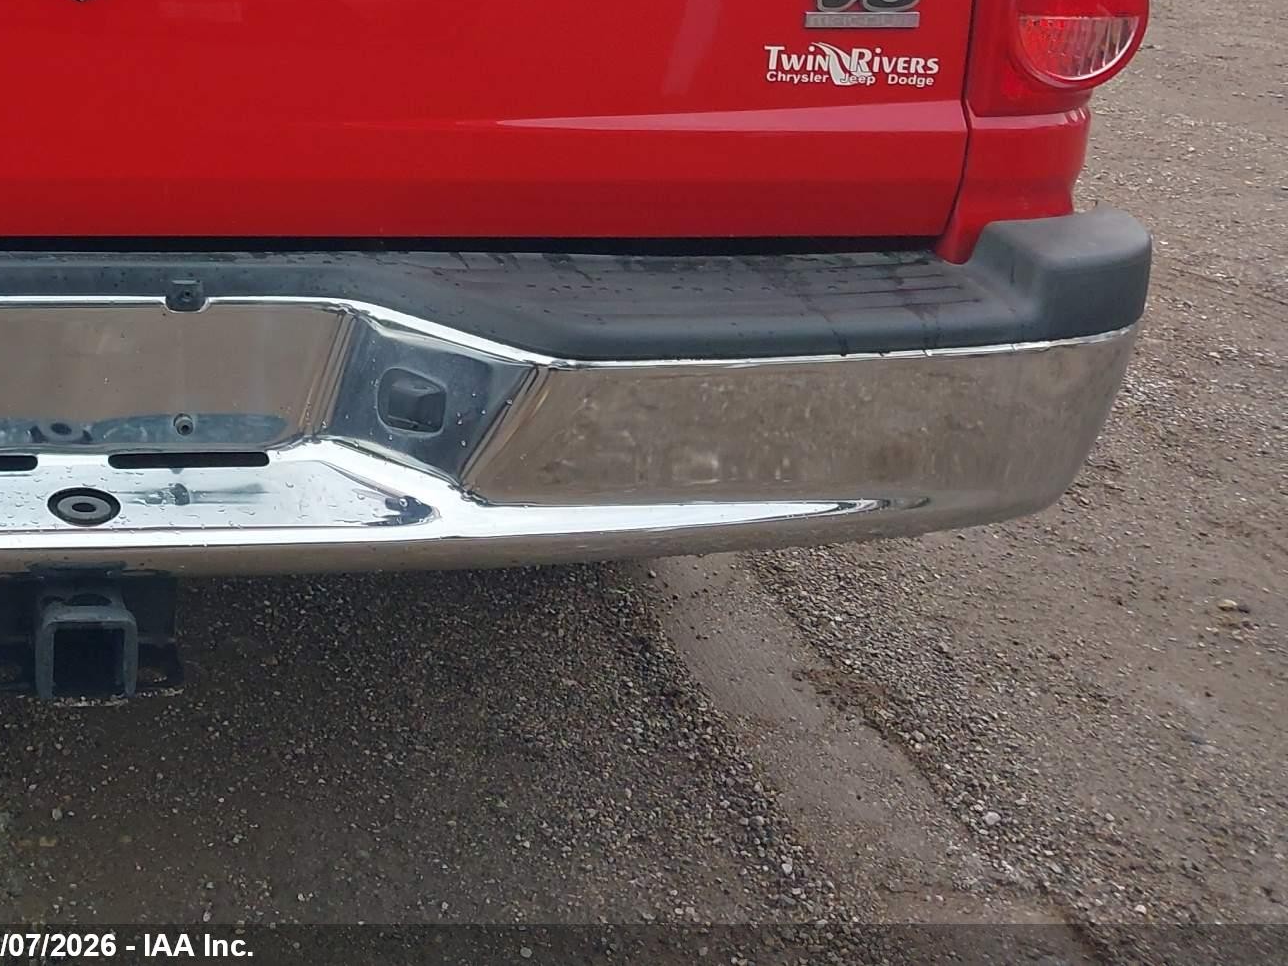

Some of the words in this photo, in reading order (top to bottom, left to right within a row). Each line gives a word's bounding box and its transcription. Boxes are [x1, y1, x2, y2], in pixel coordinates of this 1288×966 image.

[766, 70, 830, 85] Chrysler
[840, 73, 876, 86] Jeep
[887, 73, 934, 88] Dodge
